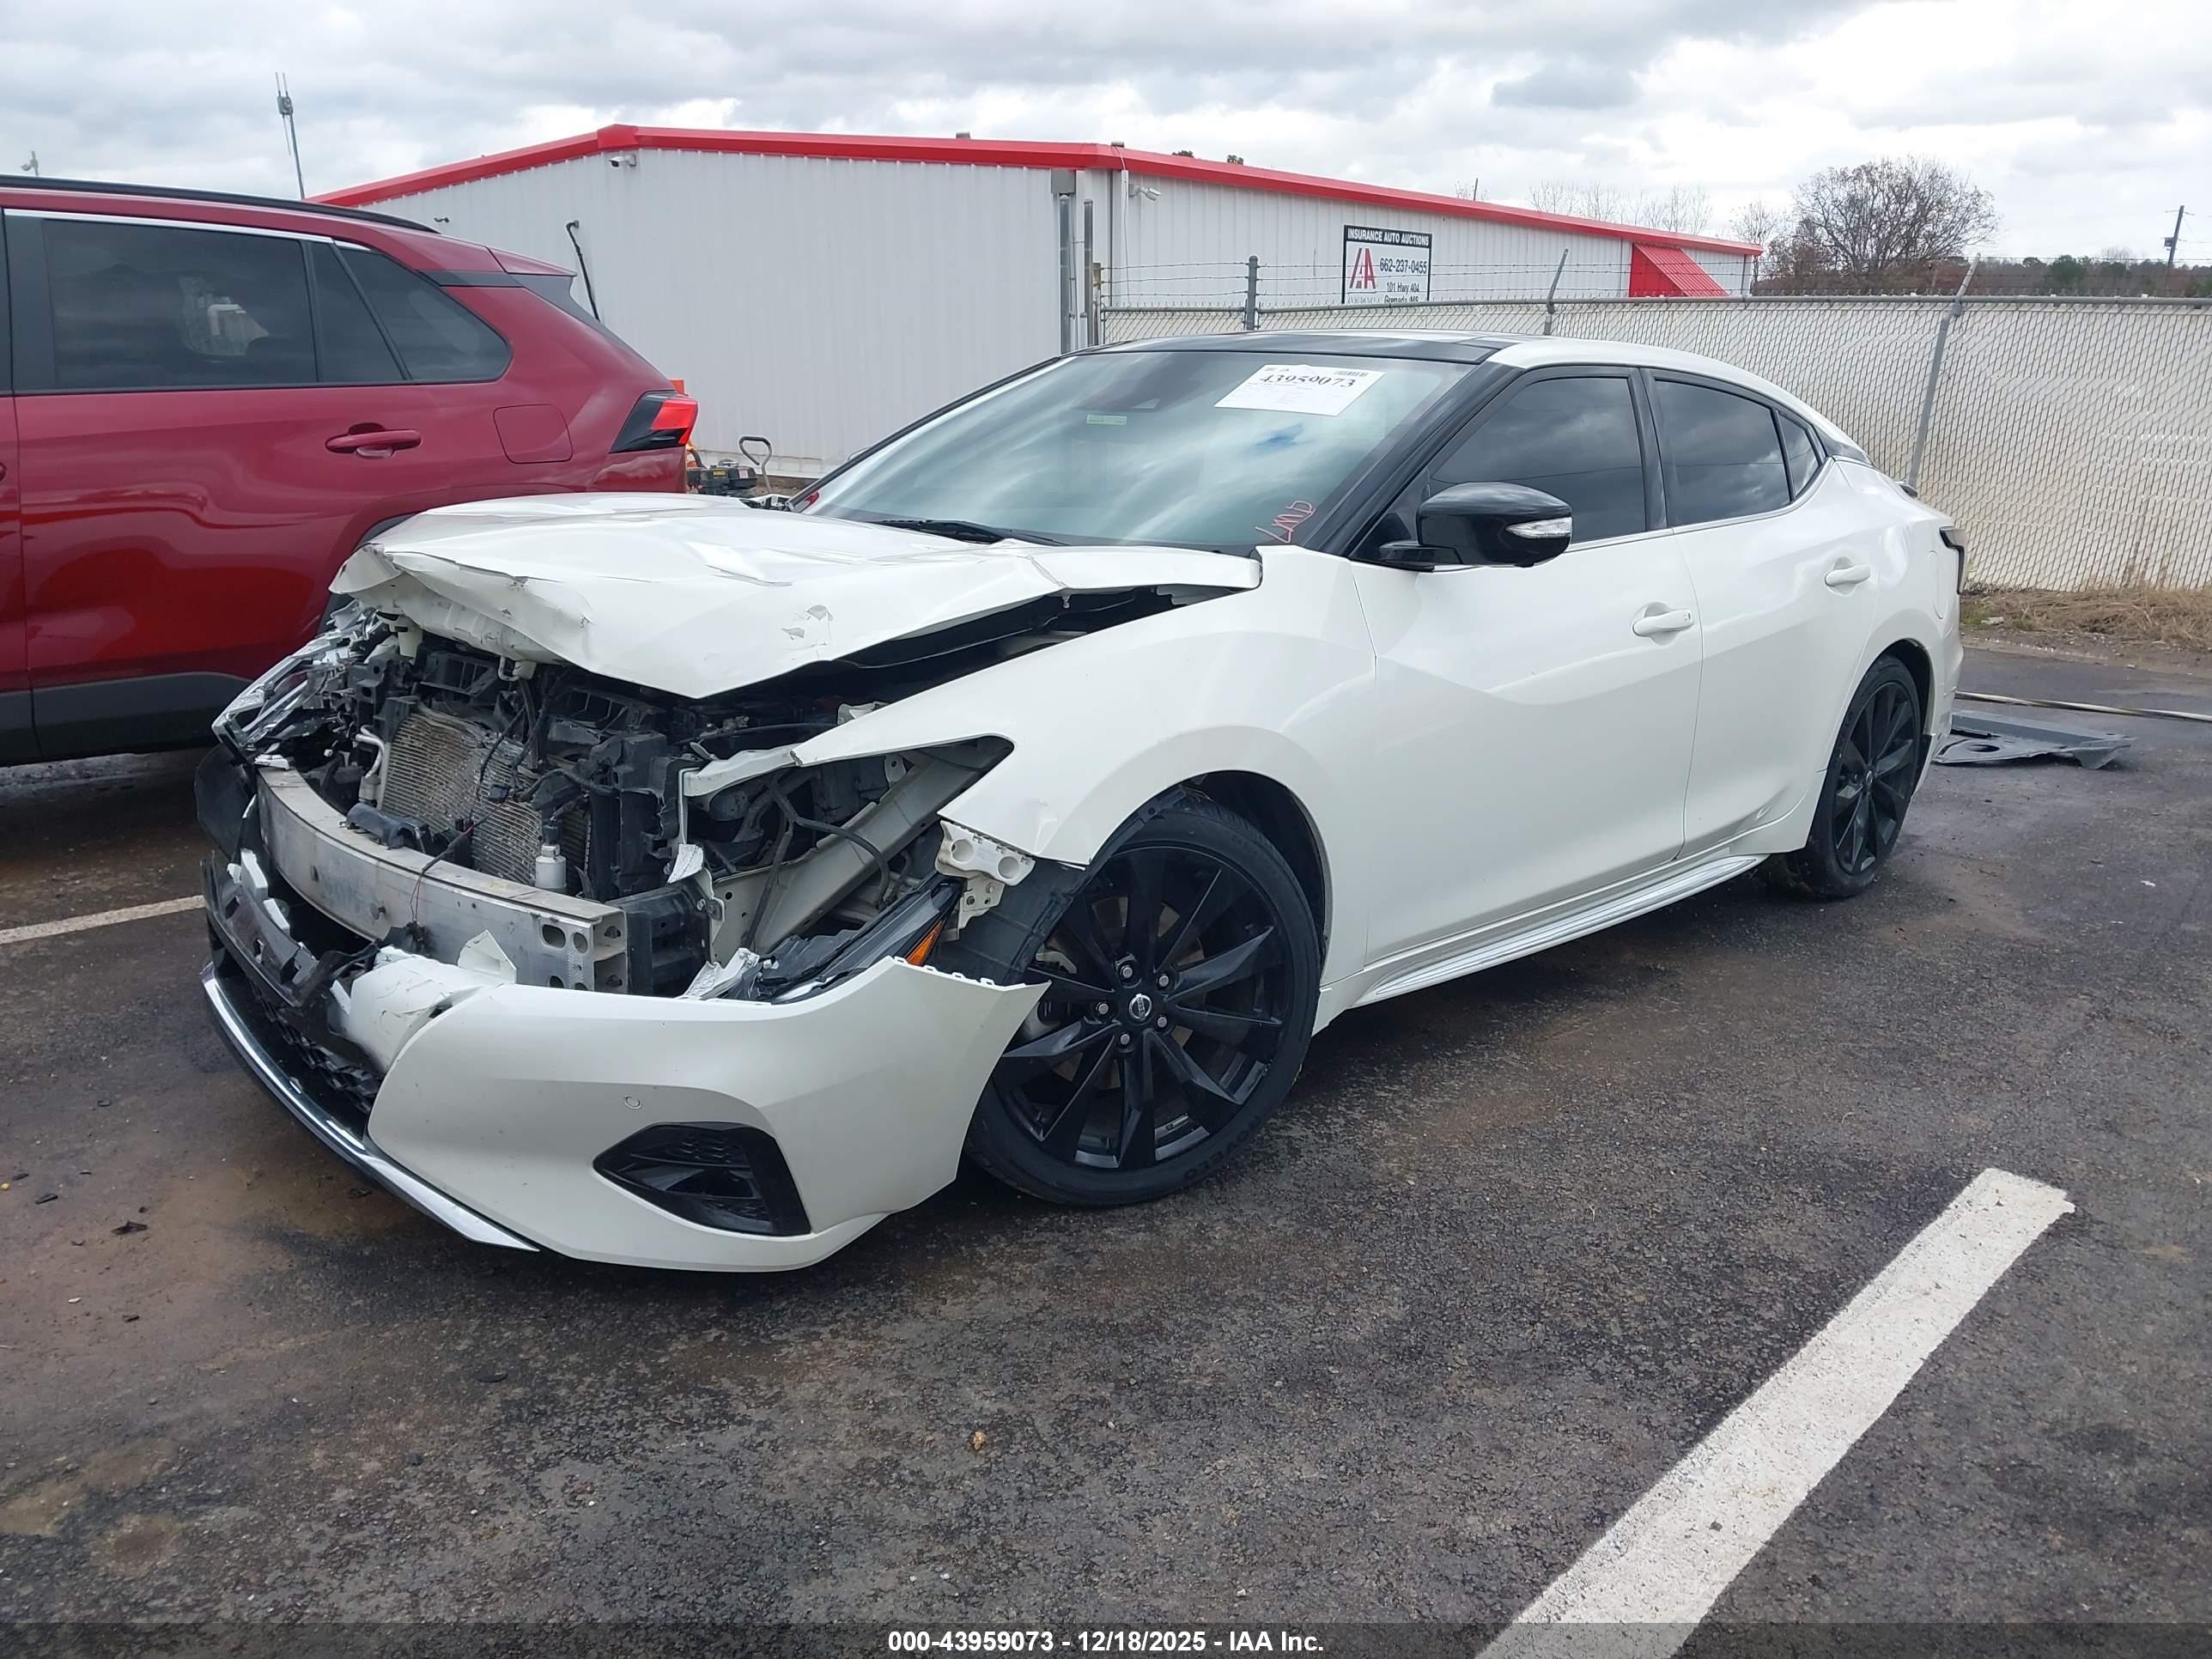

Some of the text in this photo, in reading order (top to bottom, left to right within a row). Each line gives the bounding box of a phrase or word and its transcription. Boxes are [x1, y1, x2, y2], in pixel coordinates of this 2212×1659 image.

[1347, 228, 1430, 246] INSURANCE AUTO AUCTIONS
[1379, 257, 1427, 274] 662-237-0455
[1387, 281, 1396, 293] 101
[1397, 282, 1409, 295] Hwy
[1260, 374, 1357, 388] 43959073
